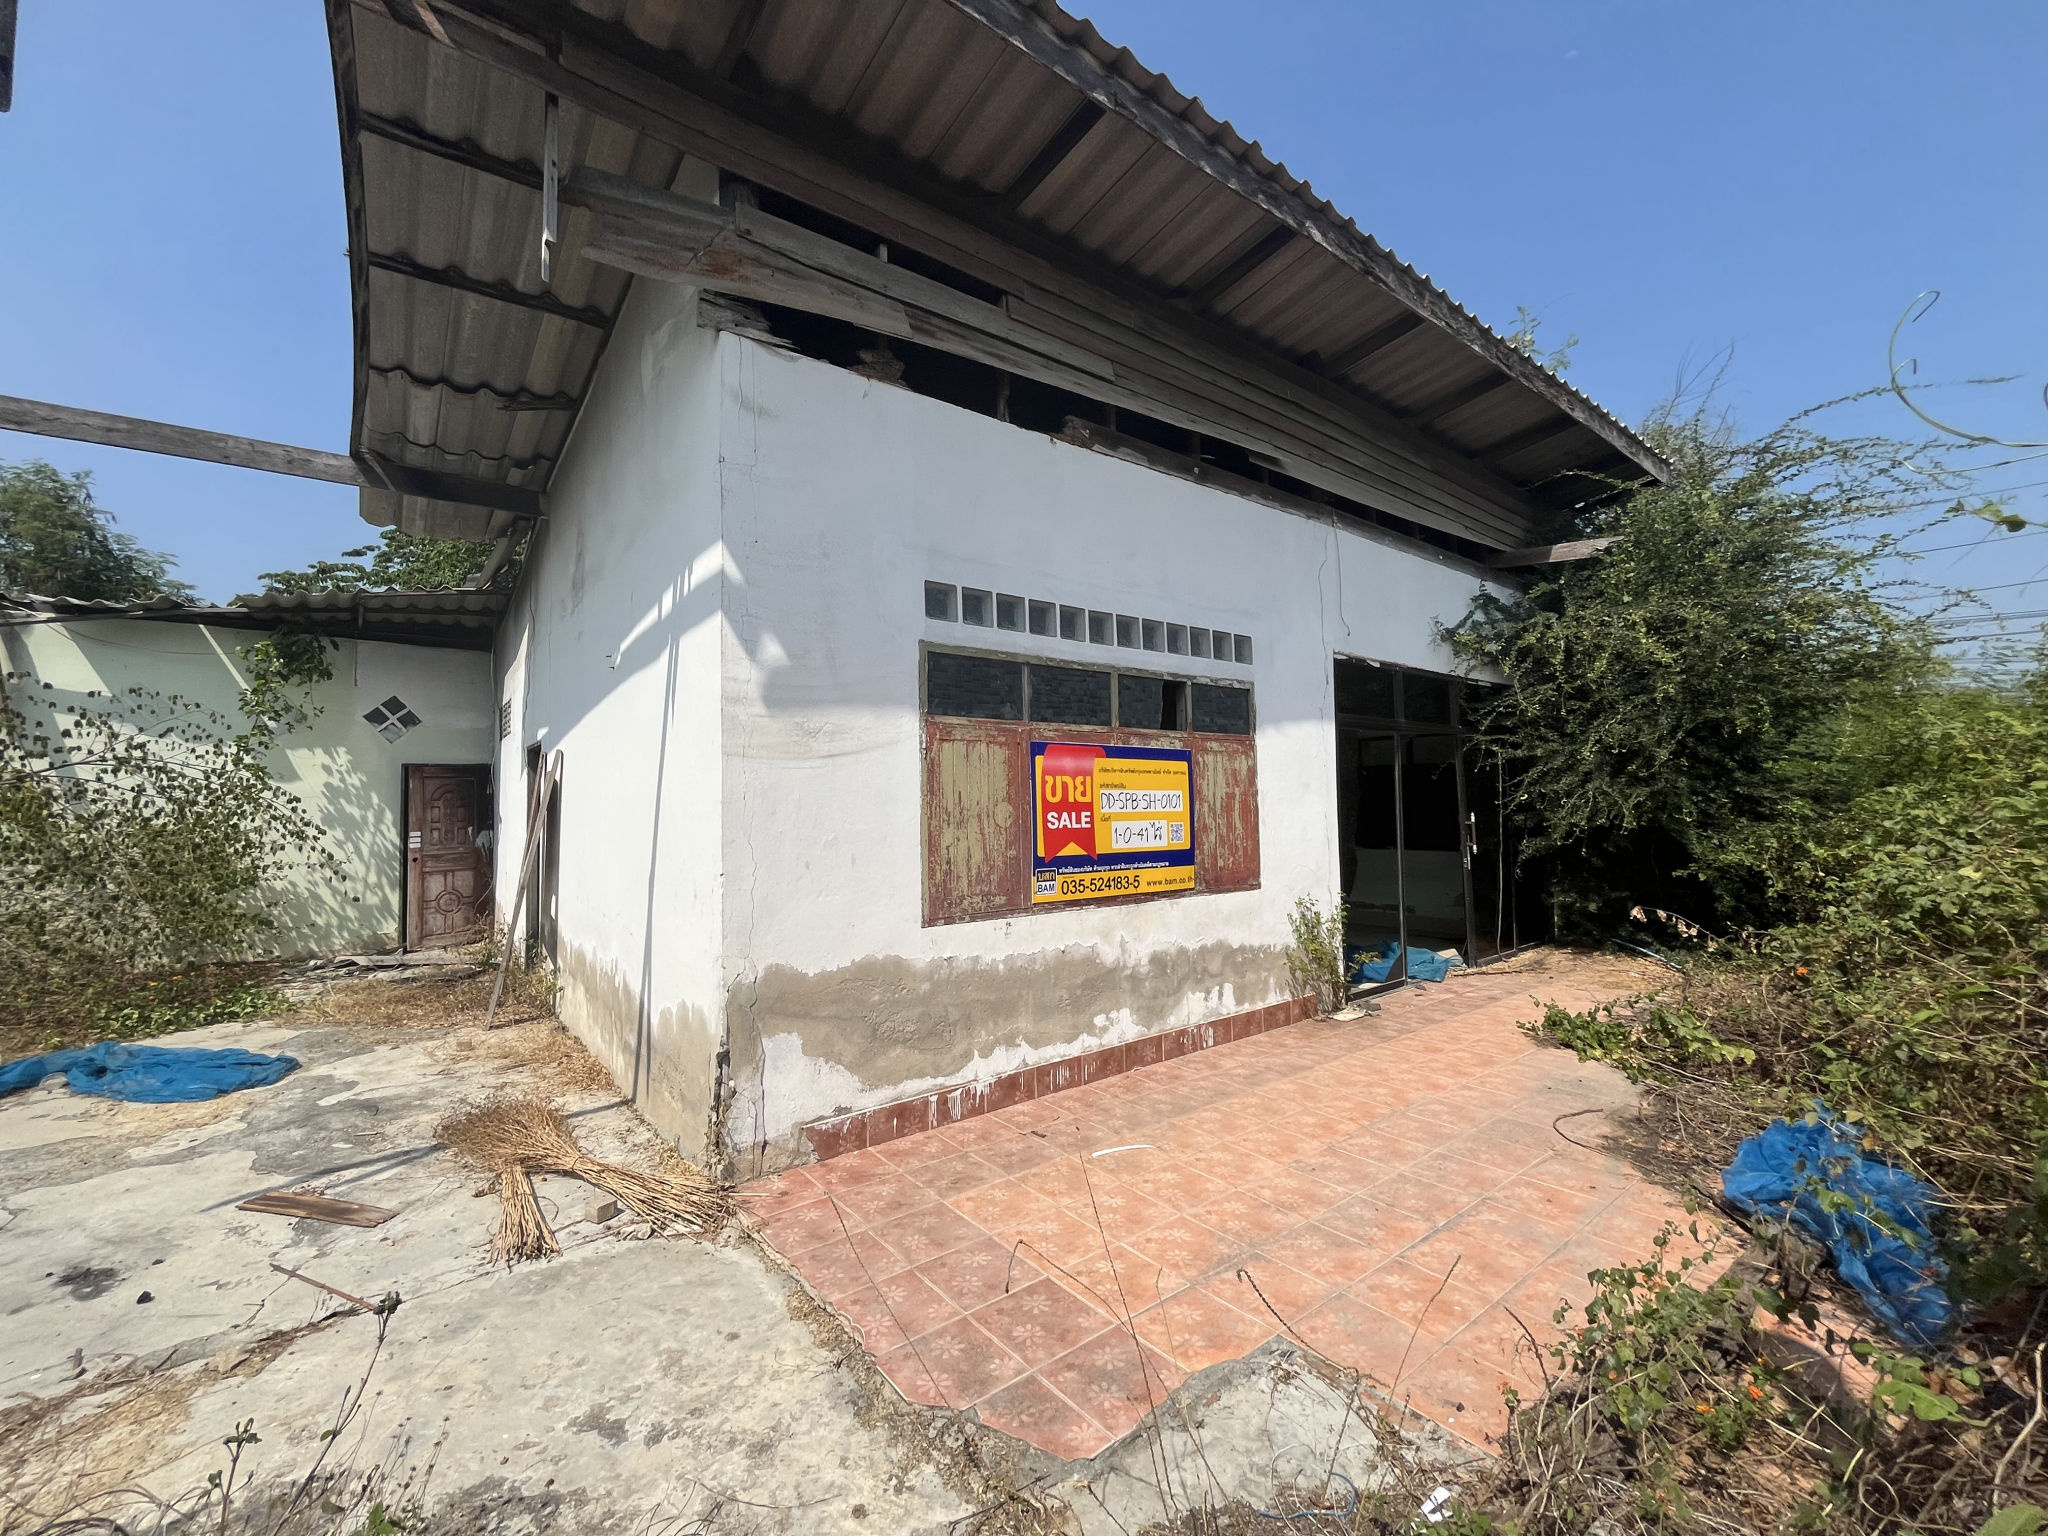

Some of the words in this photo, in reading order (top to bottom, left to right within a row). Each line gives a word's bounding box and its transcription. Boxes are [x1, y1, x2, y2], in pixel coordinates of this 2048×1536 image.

[1045, 775, 1092, 803] ขาย
[1046, 811, 1091, 829] SALE
[1114, 827, 1149, 844] 1-0-41
[1037, 883, 1055, 893] BAM
[1061, 875, 1140, 895] 035-524183-5
[1146, 875, 1193, 887] www.bam.co.th
